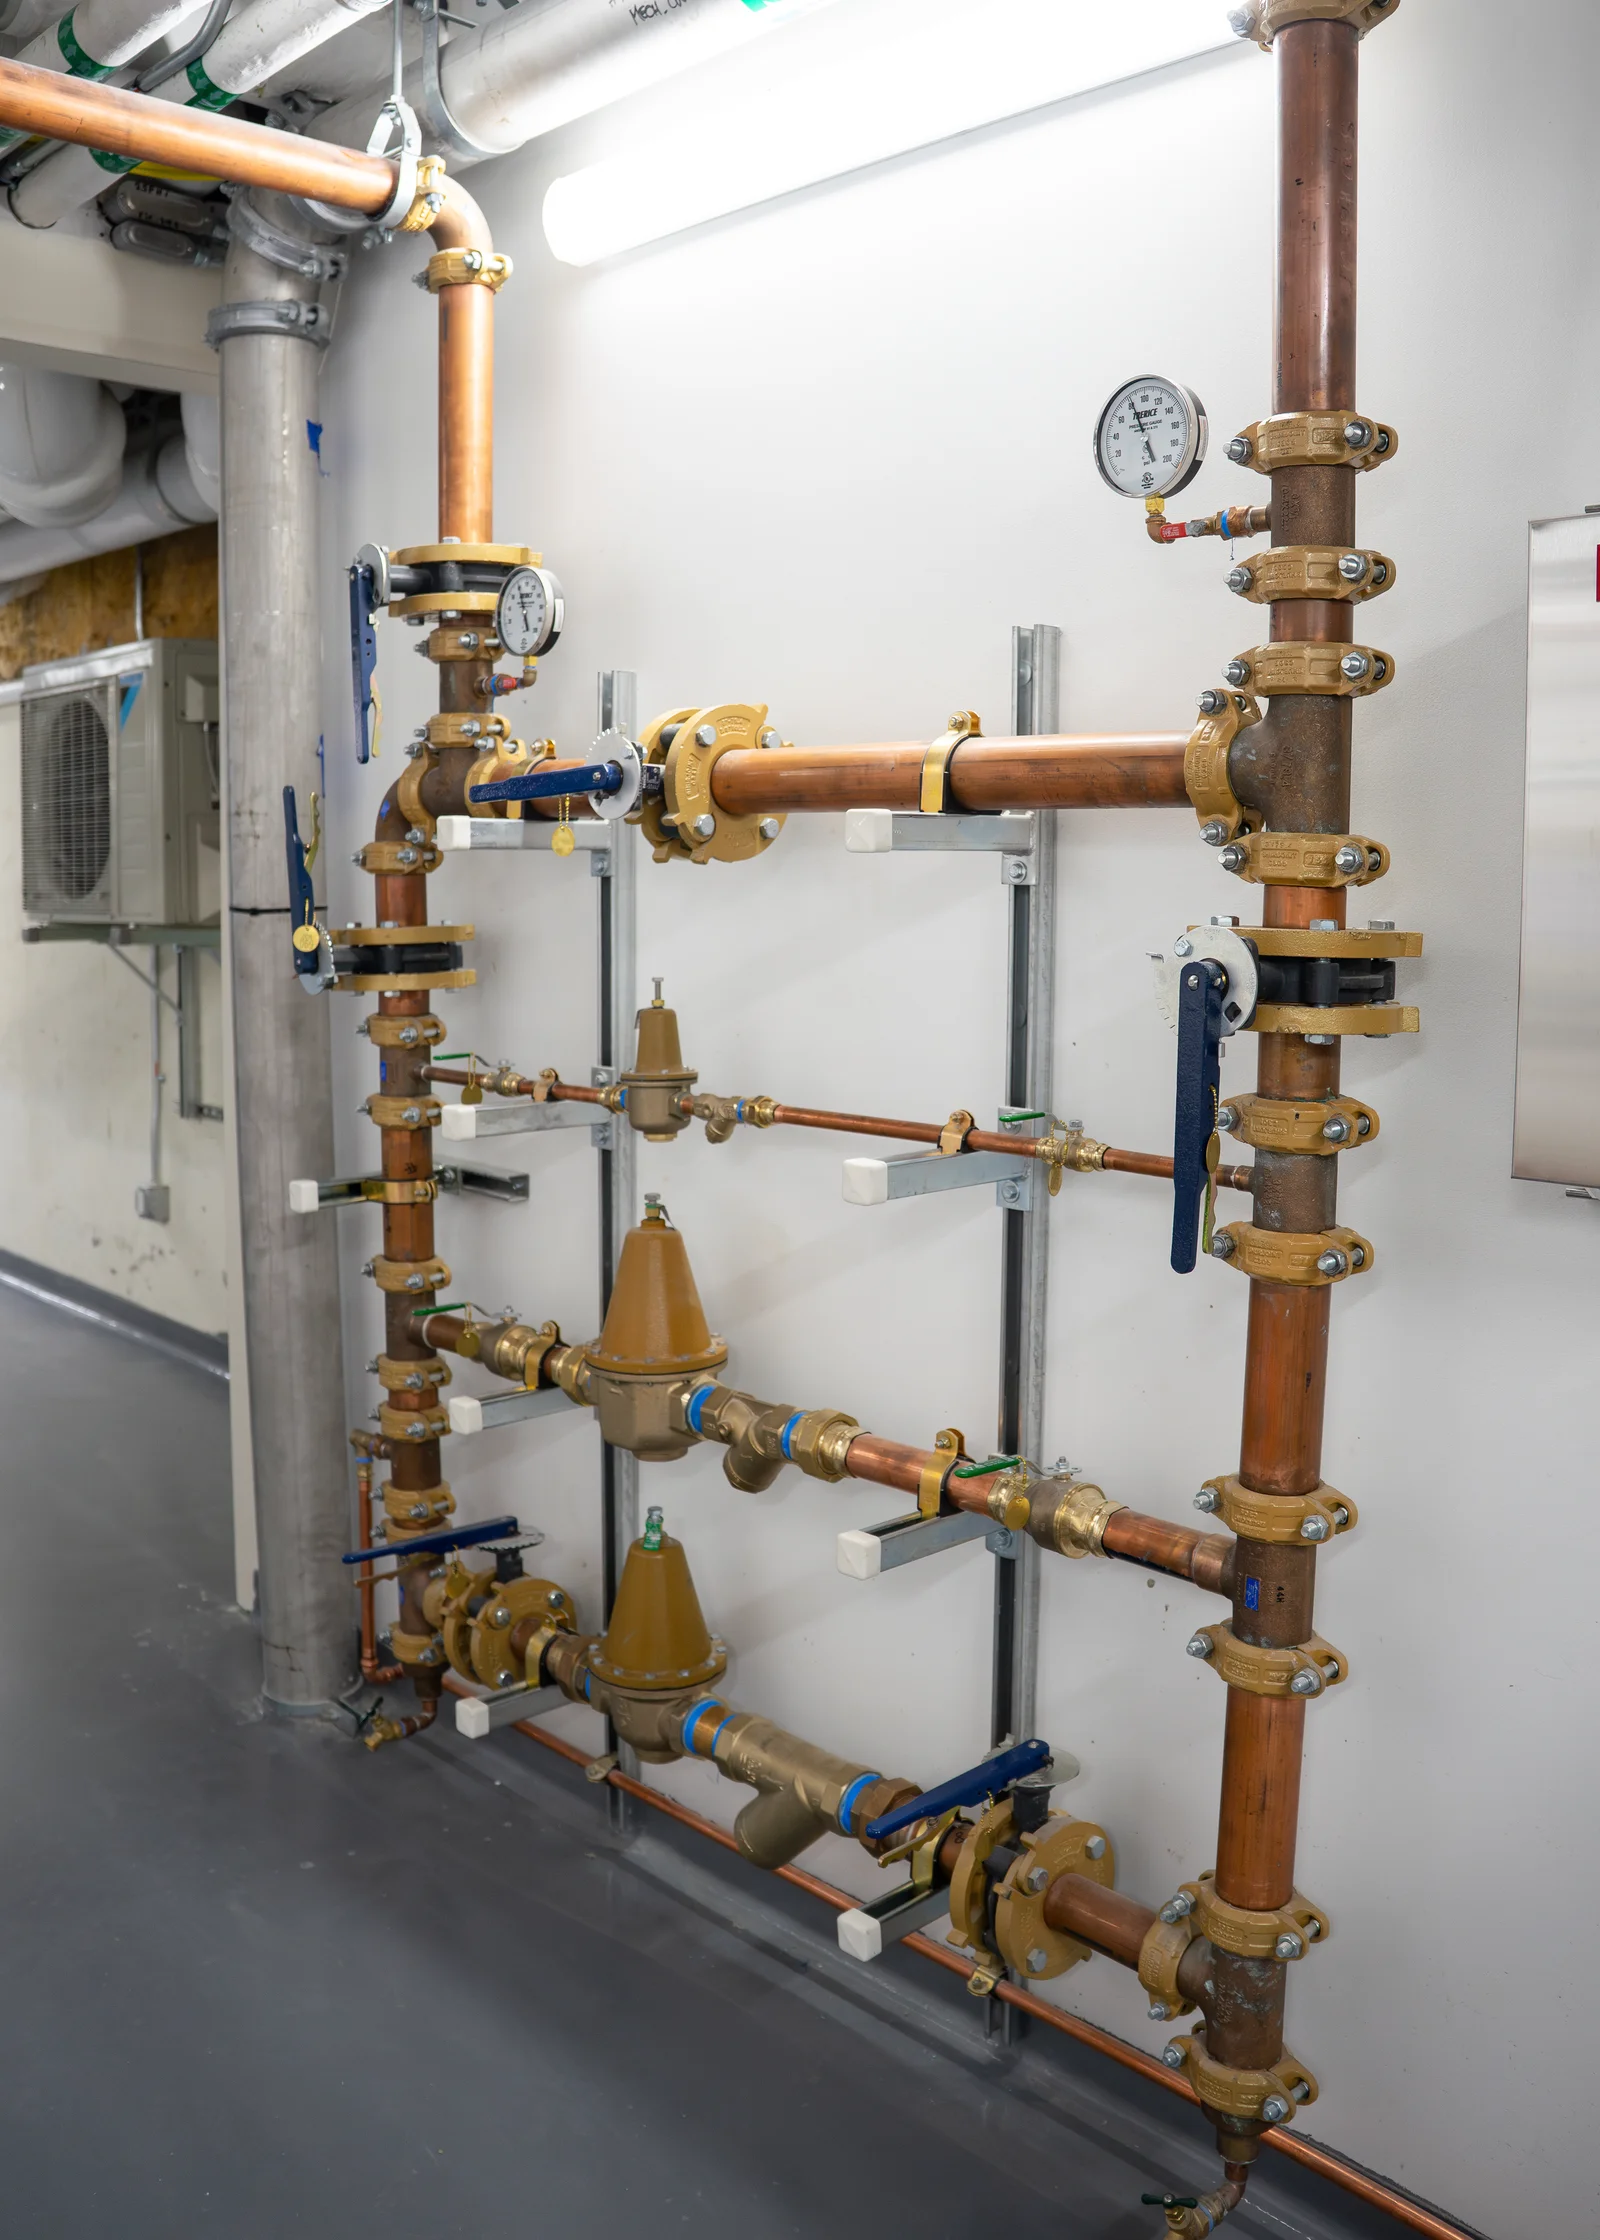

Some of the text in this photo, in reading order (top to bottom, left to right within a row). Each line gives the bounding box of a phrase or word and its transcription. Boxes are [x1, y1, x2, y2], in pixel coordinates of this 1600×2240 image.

[1140, 394, 1149, 403] 100
[1154, 397, 1162, 405] 120
[1165, 407, 1173, 415] 140
[1171, 421, 1180, 429] 160
[1170, 439, 1178, 447] 180
[1163, 455, 1172, 463] 200
